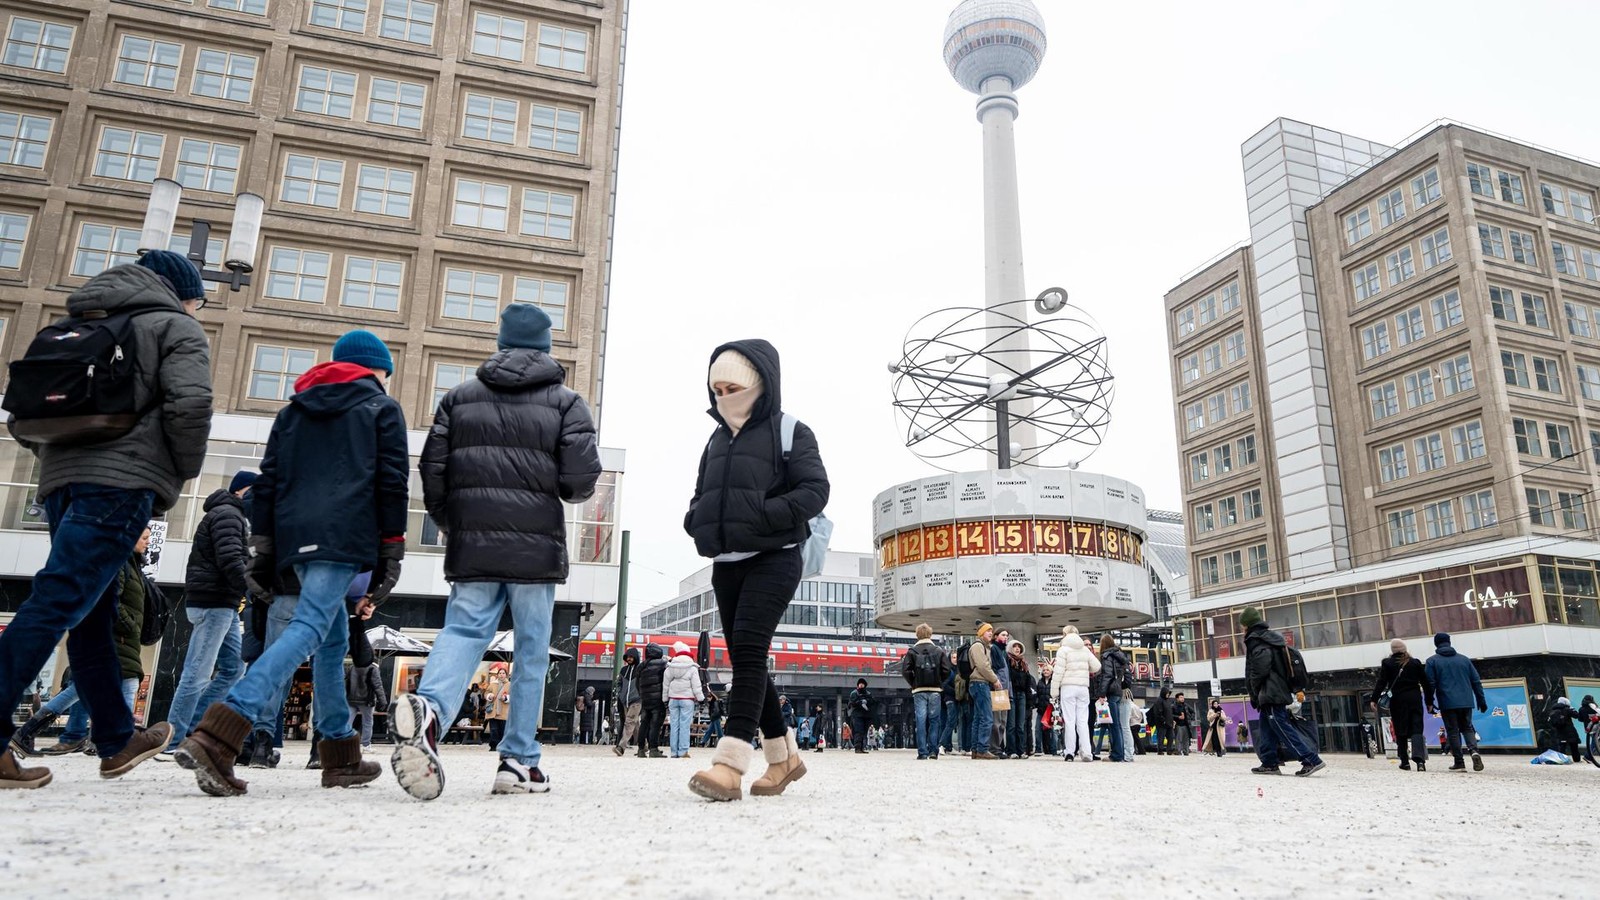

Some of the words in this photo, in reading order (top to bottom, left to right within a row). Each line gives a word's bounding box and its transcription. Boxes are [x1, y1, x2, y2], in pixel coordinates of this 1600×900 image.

[902, 534, 919, 557] 12
[927, 530, 948, 552] 13
[958, 526, 984, 548] 14
[995, 525, 1022, 547] 15
[1033, 525, 1060, 547] 16
[1068, 527, 1092, 548] 17
[1100, 530, 1118, 553] 18
[1464, 586, 1502, 610] C&A
